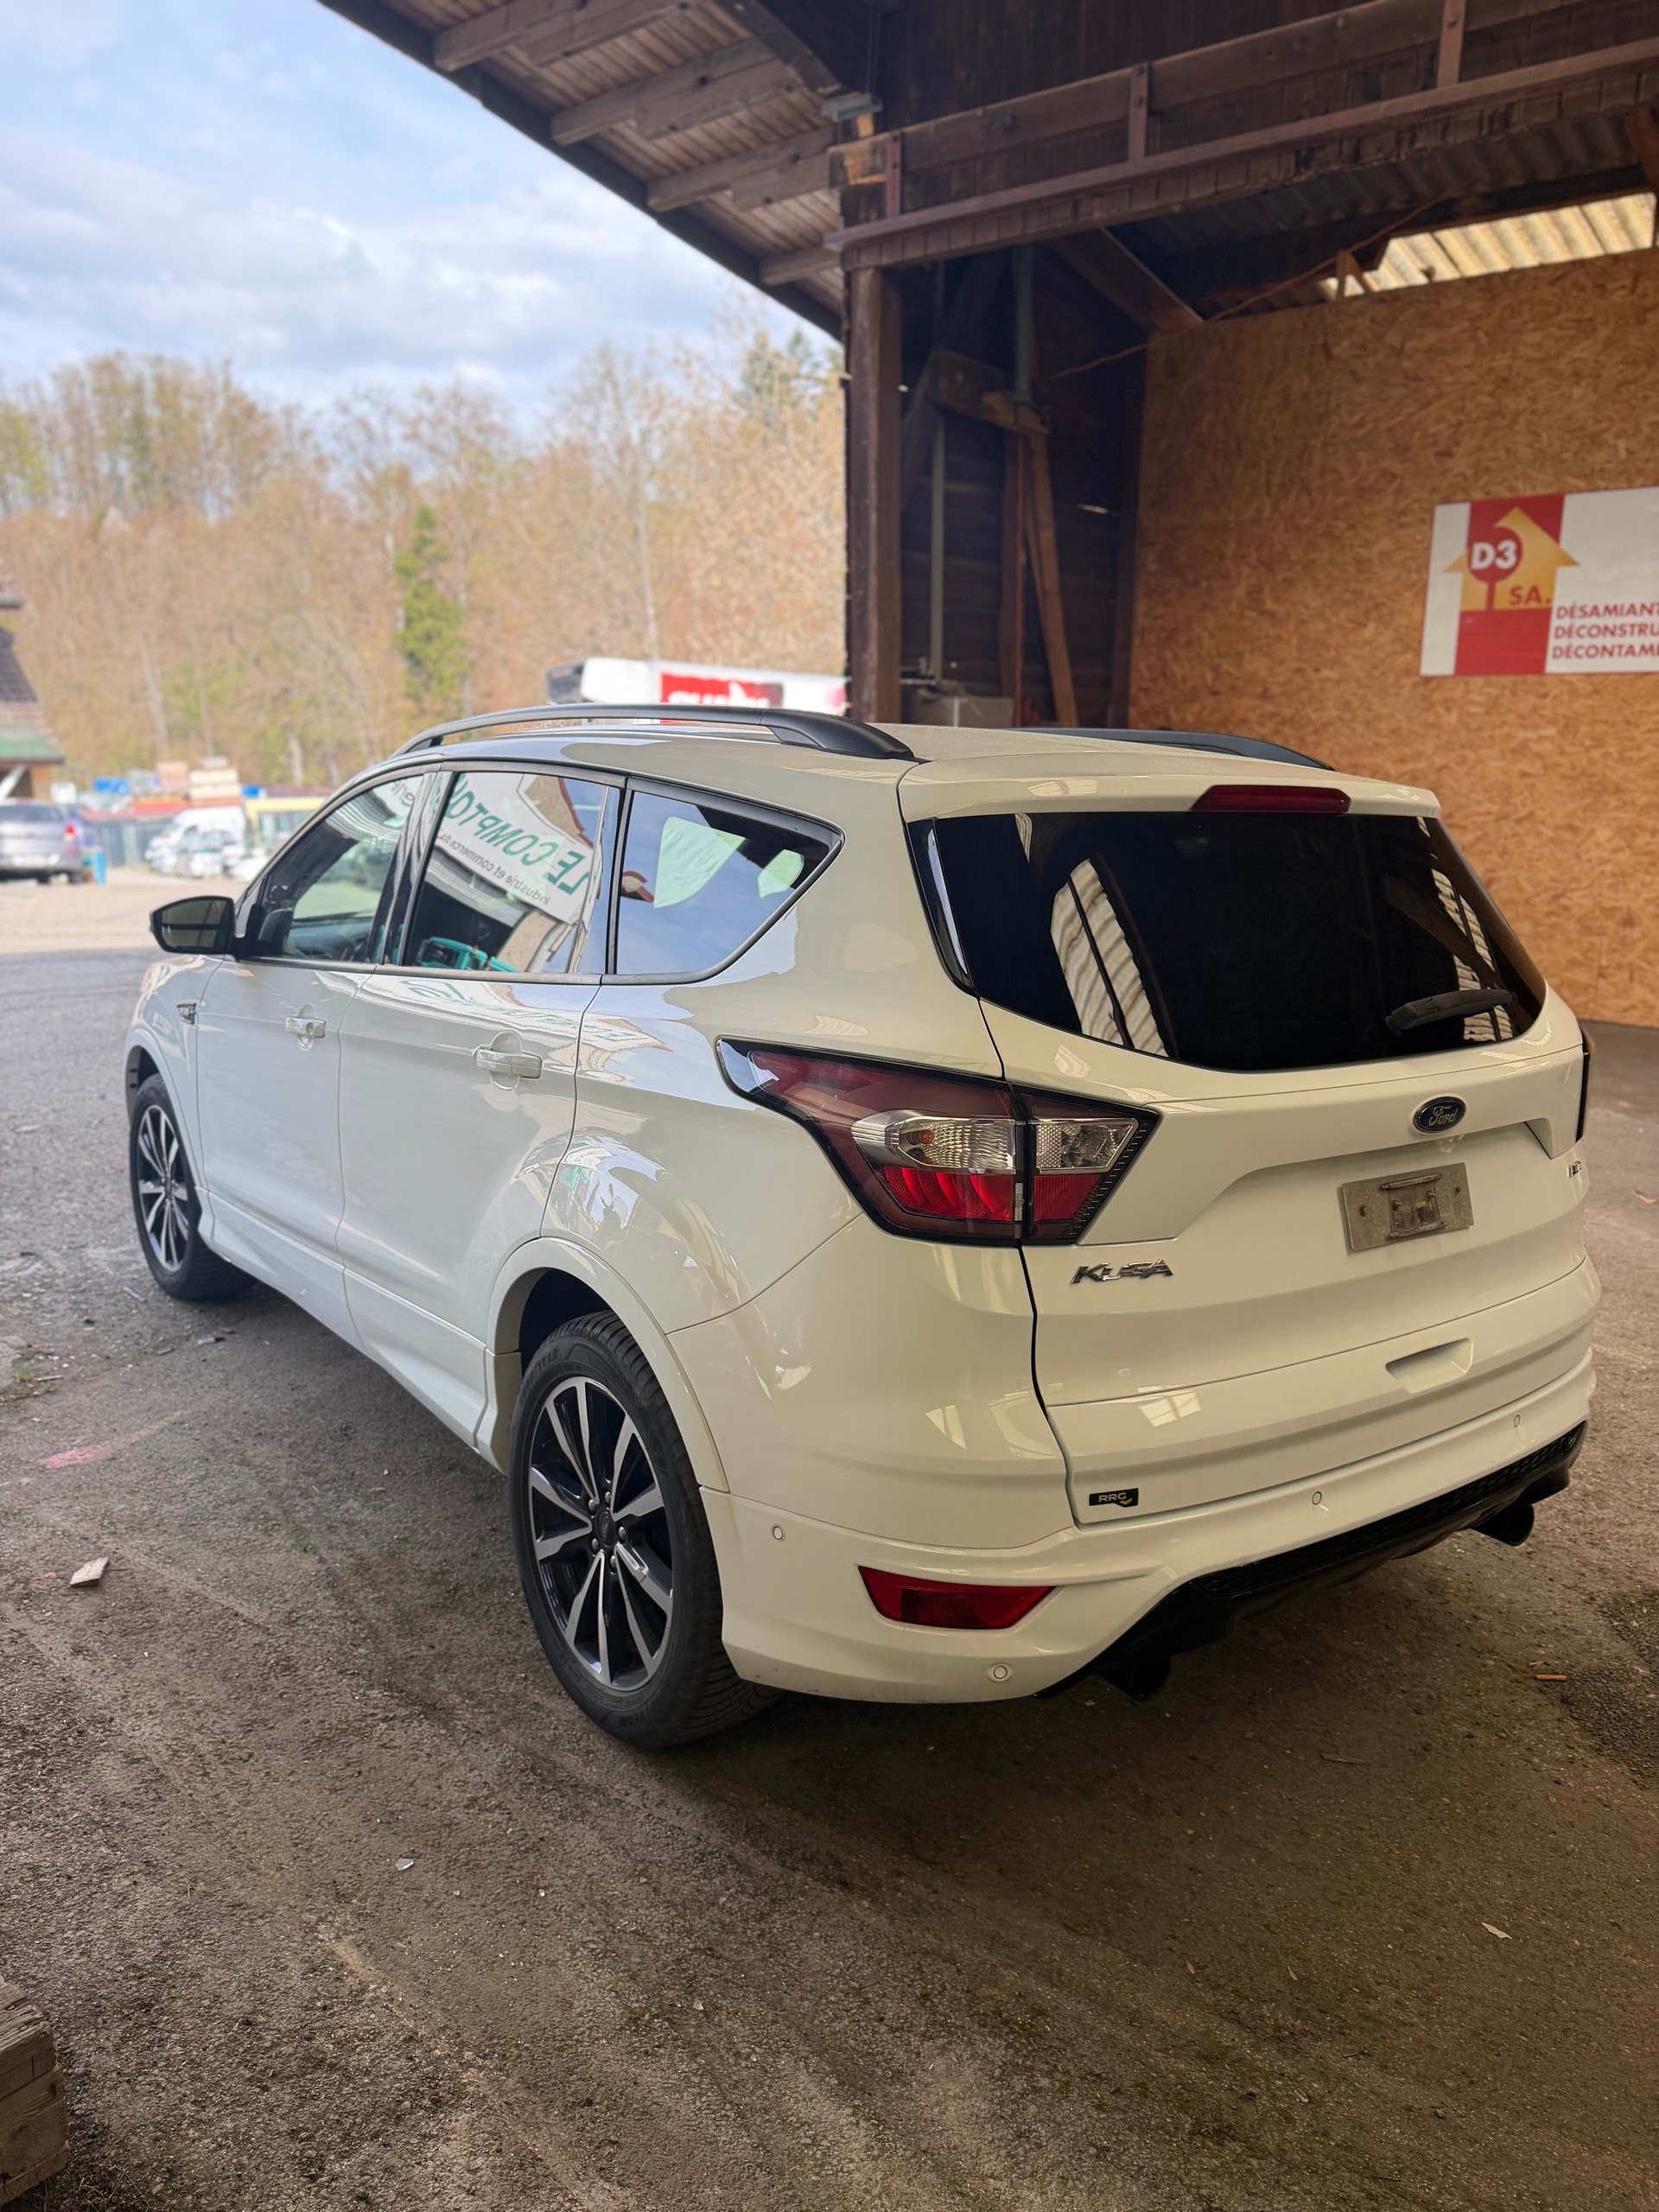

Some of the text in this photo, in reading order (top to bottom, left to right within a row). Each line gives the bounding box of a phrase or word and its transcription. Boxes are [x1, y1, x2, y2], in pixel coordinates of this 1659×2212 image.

[1471, 539, 1517, 570] D3
[1428, 1105, 1459, 1127] Ford
[1098, 1492, 1127, 1503] RRG
